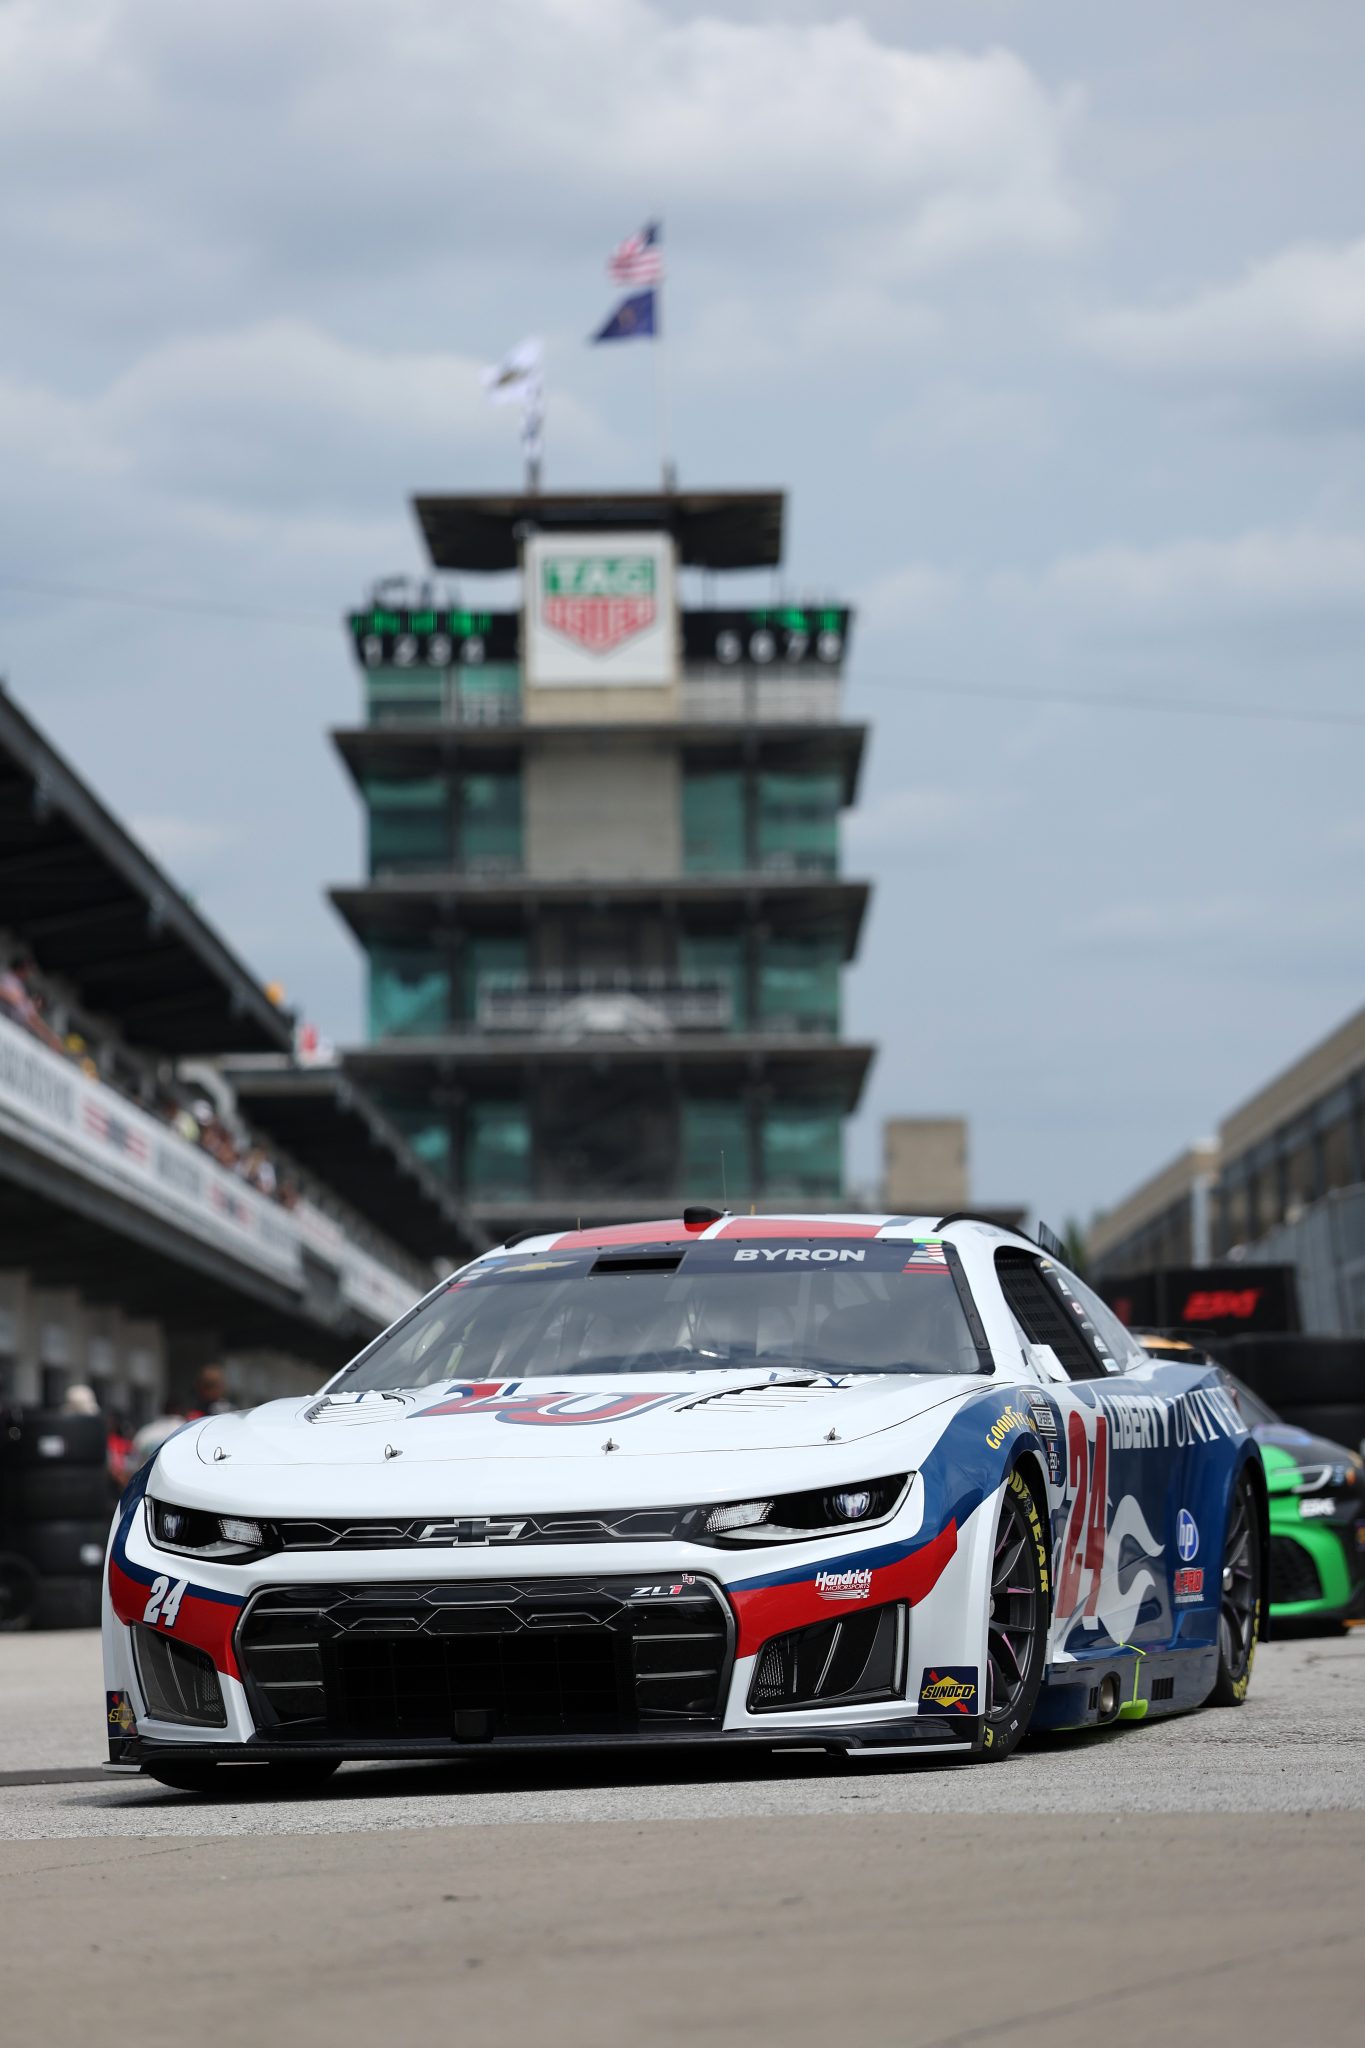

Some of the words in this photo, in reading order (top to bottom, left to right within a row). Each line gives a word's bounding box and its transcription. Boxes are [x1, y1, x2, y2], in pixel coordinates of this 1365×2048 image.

[733, 1249, 866, 1262] BYRON
[1100, 1394, 1172, 1449] LIBERTY
[1055, 1407, 1108, 1620] 24
[815, 1569, 872, 1591] Hendrick
[825, 1583, 871, 1591] MOTORSPORTS
[630, 1585, 683, 1597] ZL1
[143, 1575, 189, 1627] 24
[923, 1685, 974, 1699] SUNOCO
